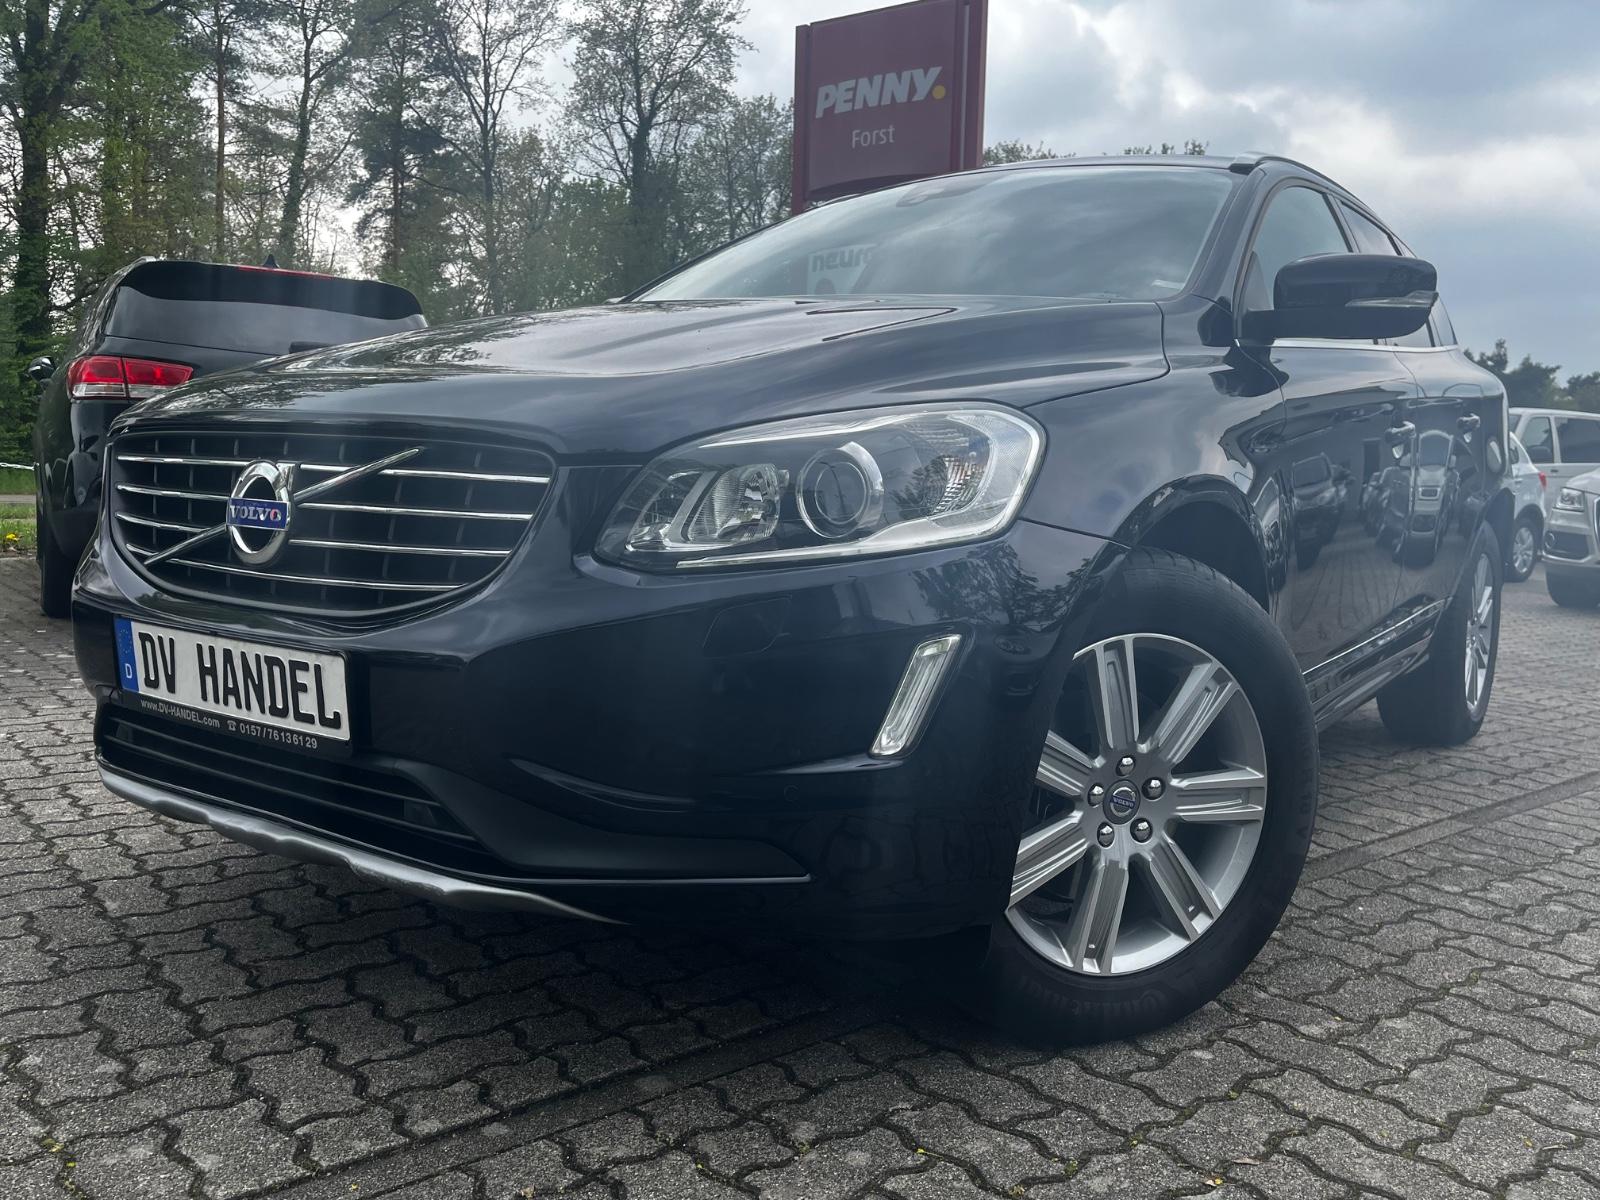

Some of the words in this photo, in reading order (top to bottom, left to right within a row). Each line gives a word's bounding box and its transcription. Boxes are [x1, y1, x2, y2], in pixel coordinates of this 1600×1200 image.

[852, 125, 895, 149] Forst
[230, 505, 282, 521] VOLVO
[125, 663, 133, 679] D
[138, 631, 176, 694] DV
[197, 643, 341, 729] HANDEL
[141, 700, 220, 728] www.DV-HANDEL.com
[239, 723, 318, 749] 0157/76136129
